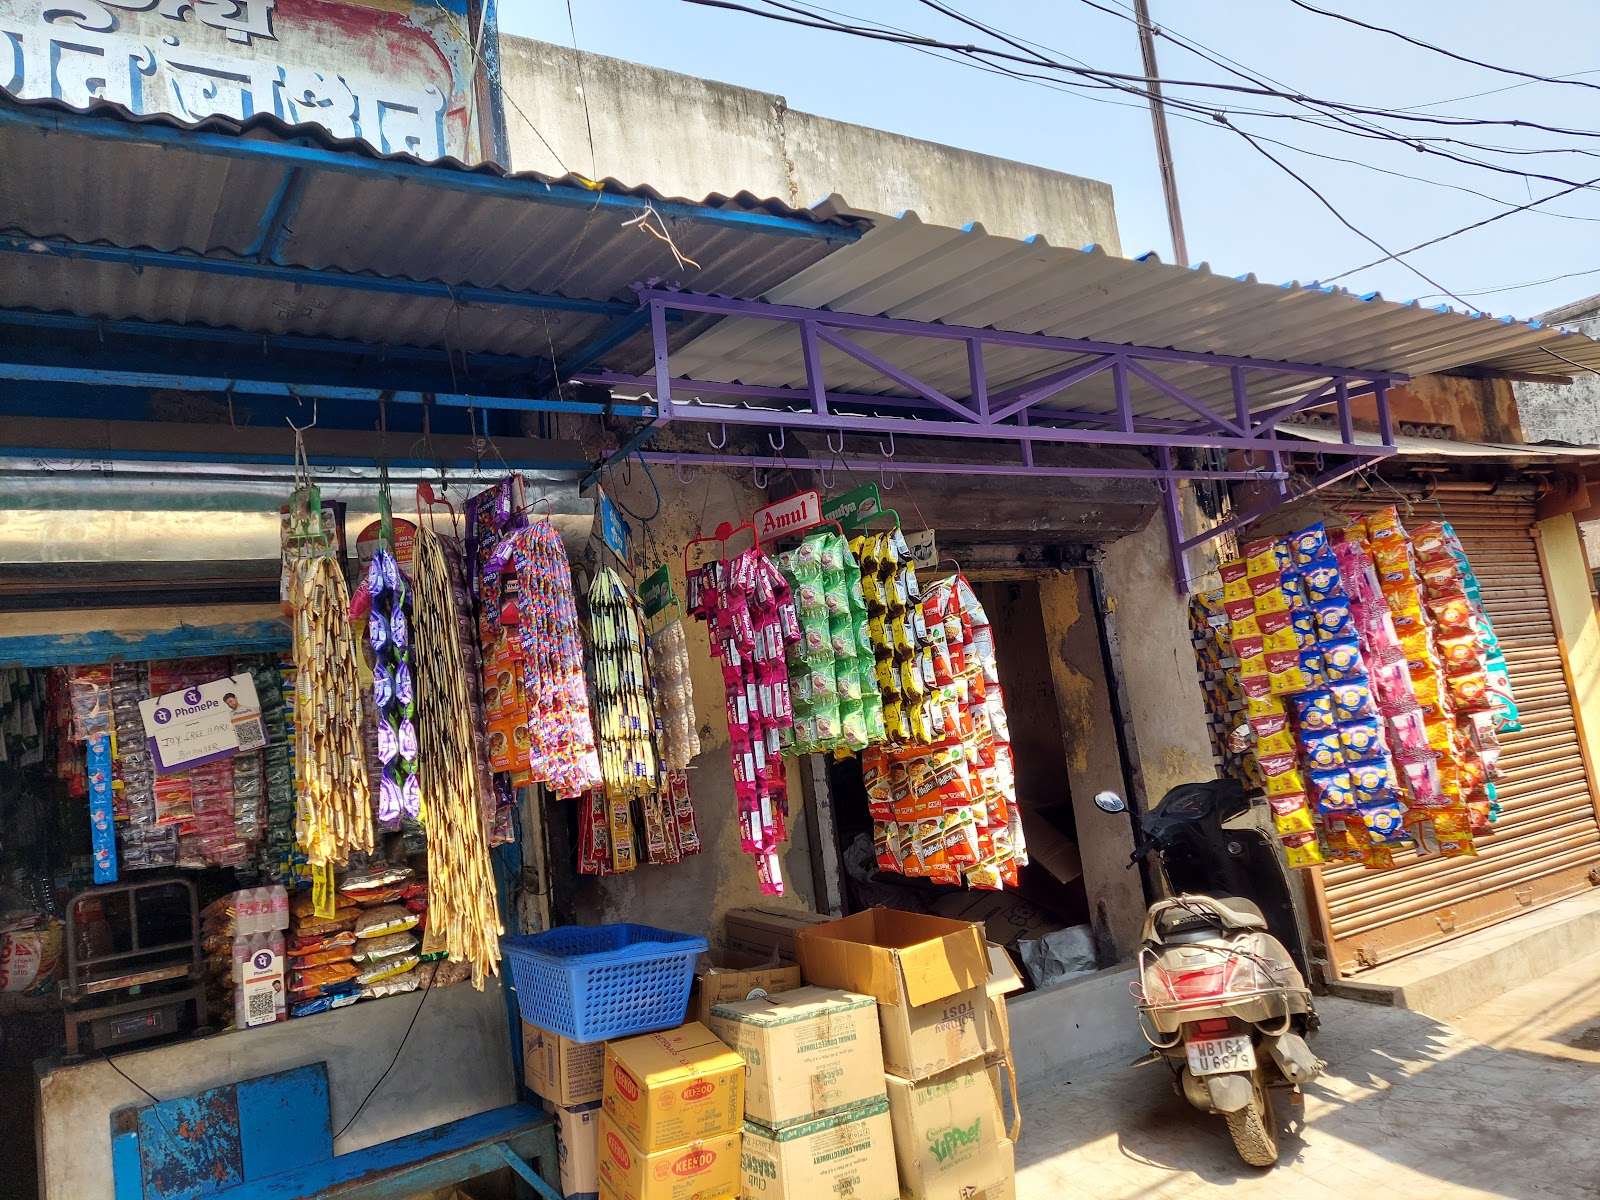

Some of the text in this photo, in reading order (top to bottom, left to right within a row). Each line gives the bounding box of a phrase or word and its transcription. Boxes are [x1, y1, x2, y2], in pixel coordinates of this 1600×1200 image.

[762, 500, 808, 536] Amul
[825, 501, 857, 521] mulya
[175, 700, 219, 717] PhonePe
[161, 736, 180, 747] JOY
[941, 1001, 974, 1021] TOST
[615, 1067, 637, 1098] KEEKOO
[749, 1174, 767, 1191] Club
